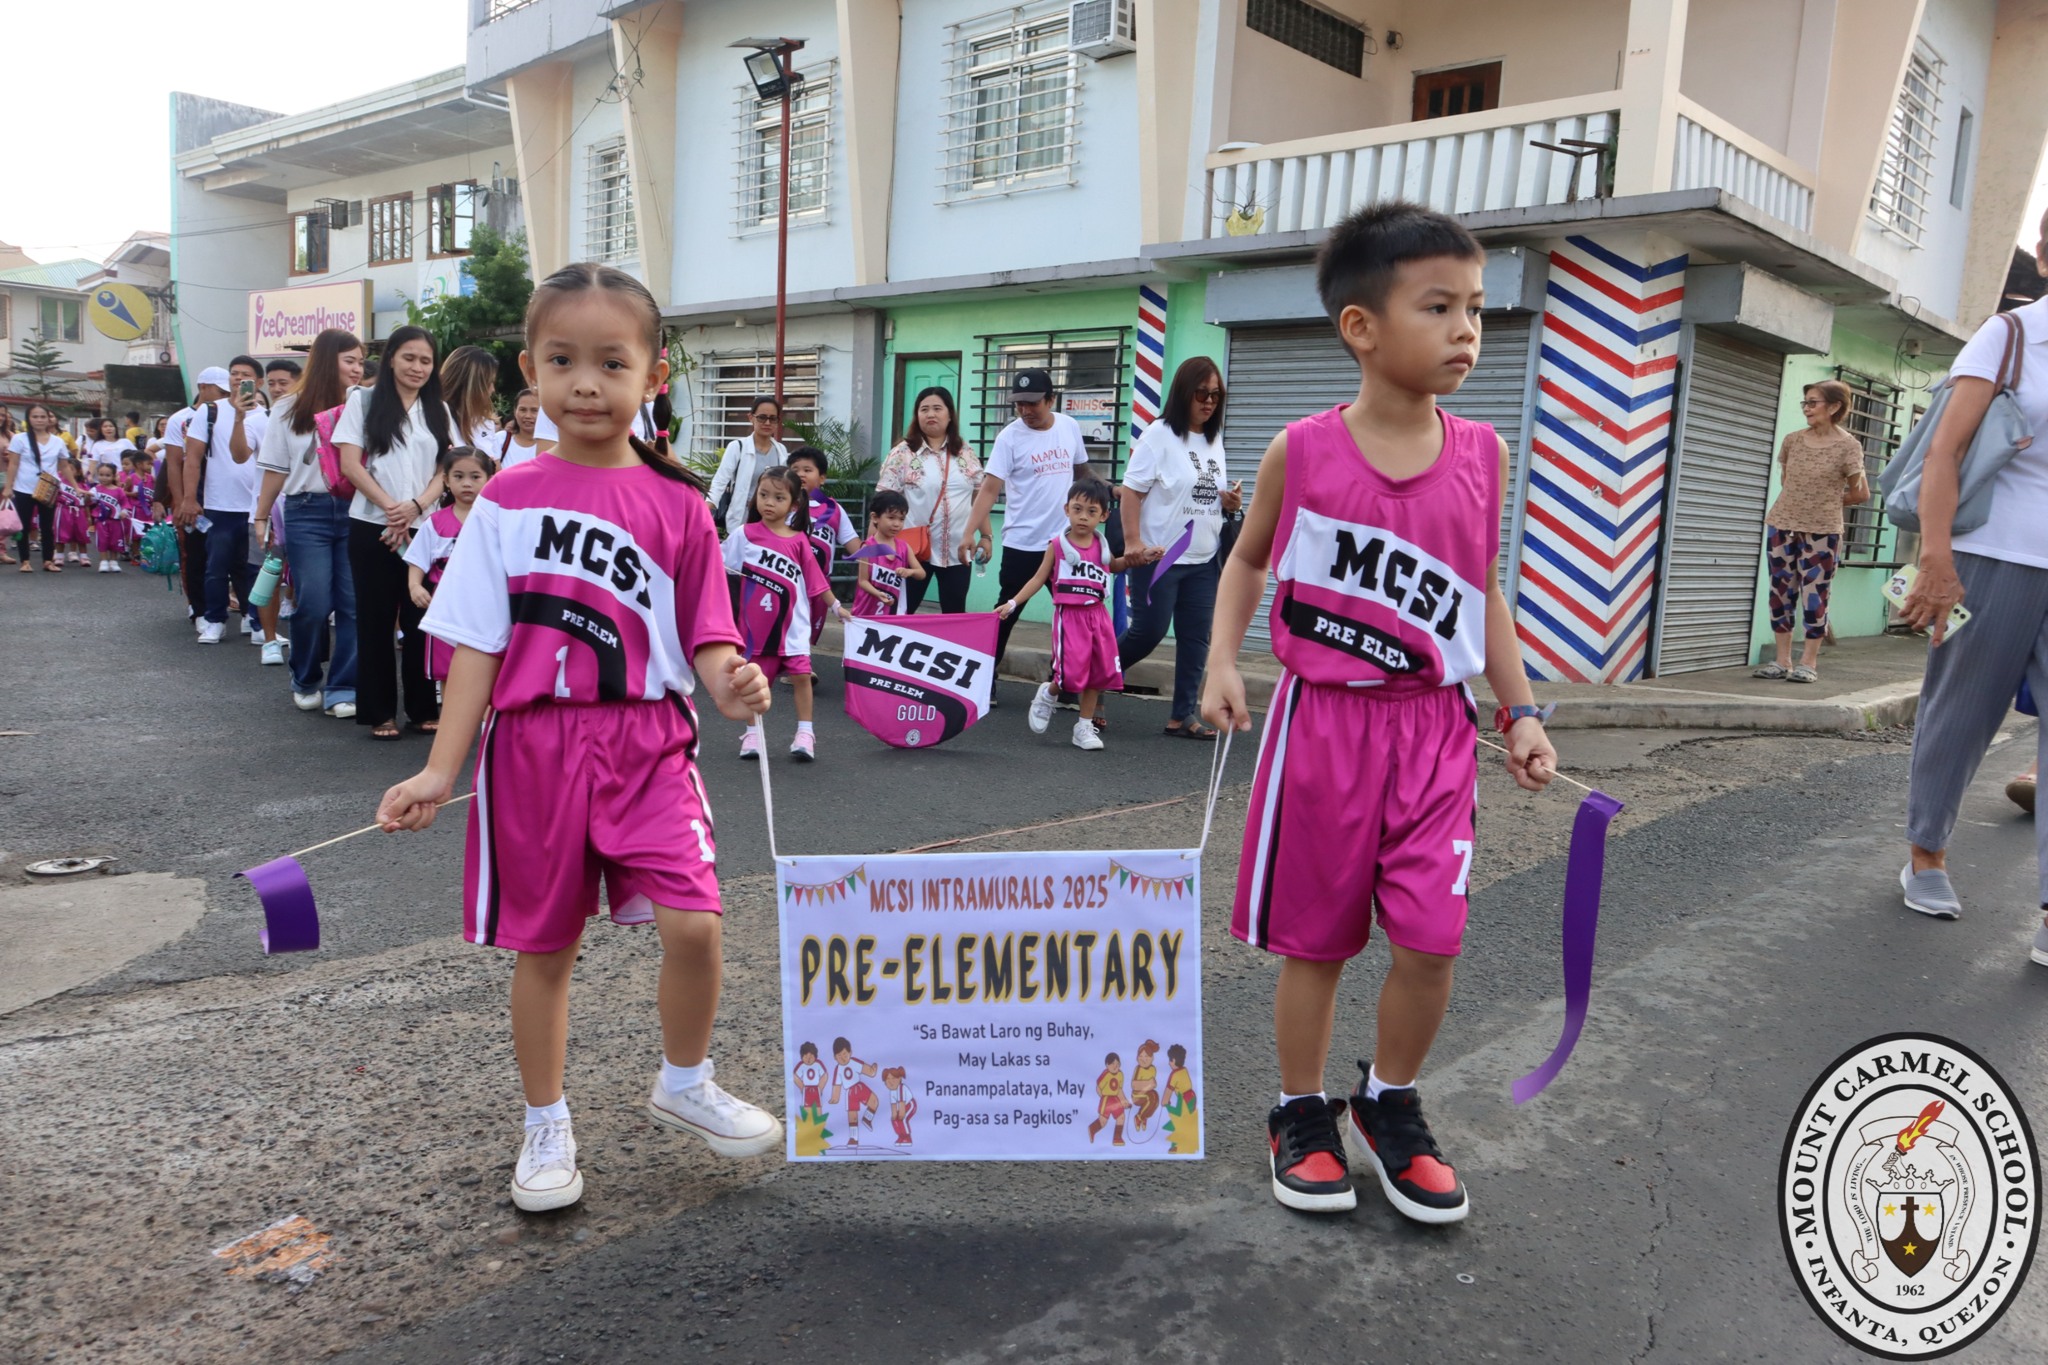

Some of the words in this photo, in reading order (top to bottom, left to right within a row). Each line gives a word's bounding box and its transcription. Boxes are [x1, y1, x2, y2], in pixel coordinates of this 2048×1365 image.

[1031, 446, 1069, 464] MAPÚA
[534, 515, 652, 611] MCSI
[758, 549, 801, 584] MCSI
[752, 574, 765, 584] PRE
[765, 580, 784, 595] ELEM
[1330, 529, 1463, 641] MCSI
[760, 593, 772, 611] 4
[875, 602, 884, 615] 2
[561, 609, 584, 628] PRE
[587, 620, 618, 649] ELEM
[1313, 616, 1357, 645] PRE
[555, 645, 571, 698] 1
[856, 627, 982, 689] MCSI
[869, 677, 892, 690] PRE
[893, 683, 925, 699] ELEM
[897, 704, 937, 721] GOLD
[690, 819, 715, 863] 1
[1452, 840, 1472, 895] 7
[870, 879, 914, 913] MCSI
[921, 874, 1053, 912] INTRAMURALS
[1062, 874, 1109, 909] 2025
[799, 928, 1184, 1006] PRE-ELEMENTARY
[913, 1024, 937, 1041] “Sa
[941, 1024, 986, 1040] Bawat
[988, 1024, 1021, 1040] Laro
[1025, 1026, 1043, 1043] ng
[1047, 1022, 1094, 1042] Buhay,
[959, 1052, 986, 1070] May
[988, 1051, 1031, 1068] Lakas
[1034, 1055, 1050, 1067] sa
[925, 1080, 1053, 1100] Pananampalataya,
[1057, 1079, 1085, 1099] May
[933, 1110, 990, 1129] Pag-asa
[994, 1112, 1011, 1126] sa
[1014, 1109, 1079, 1128] Pagkilos”
